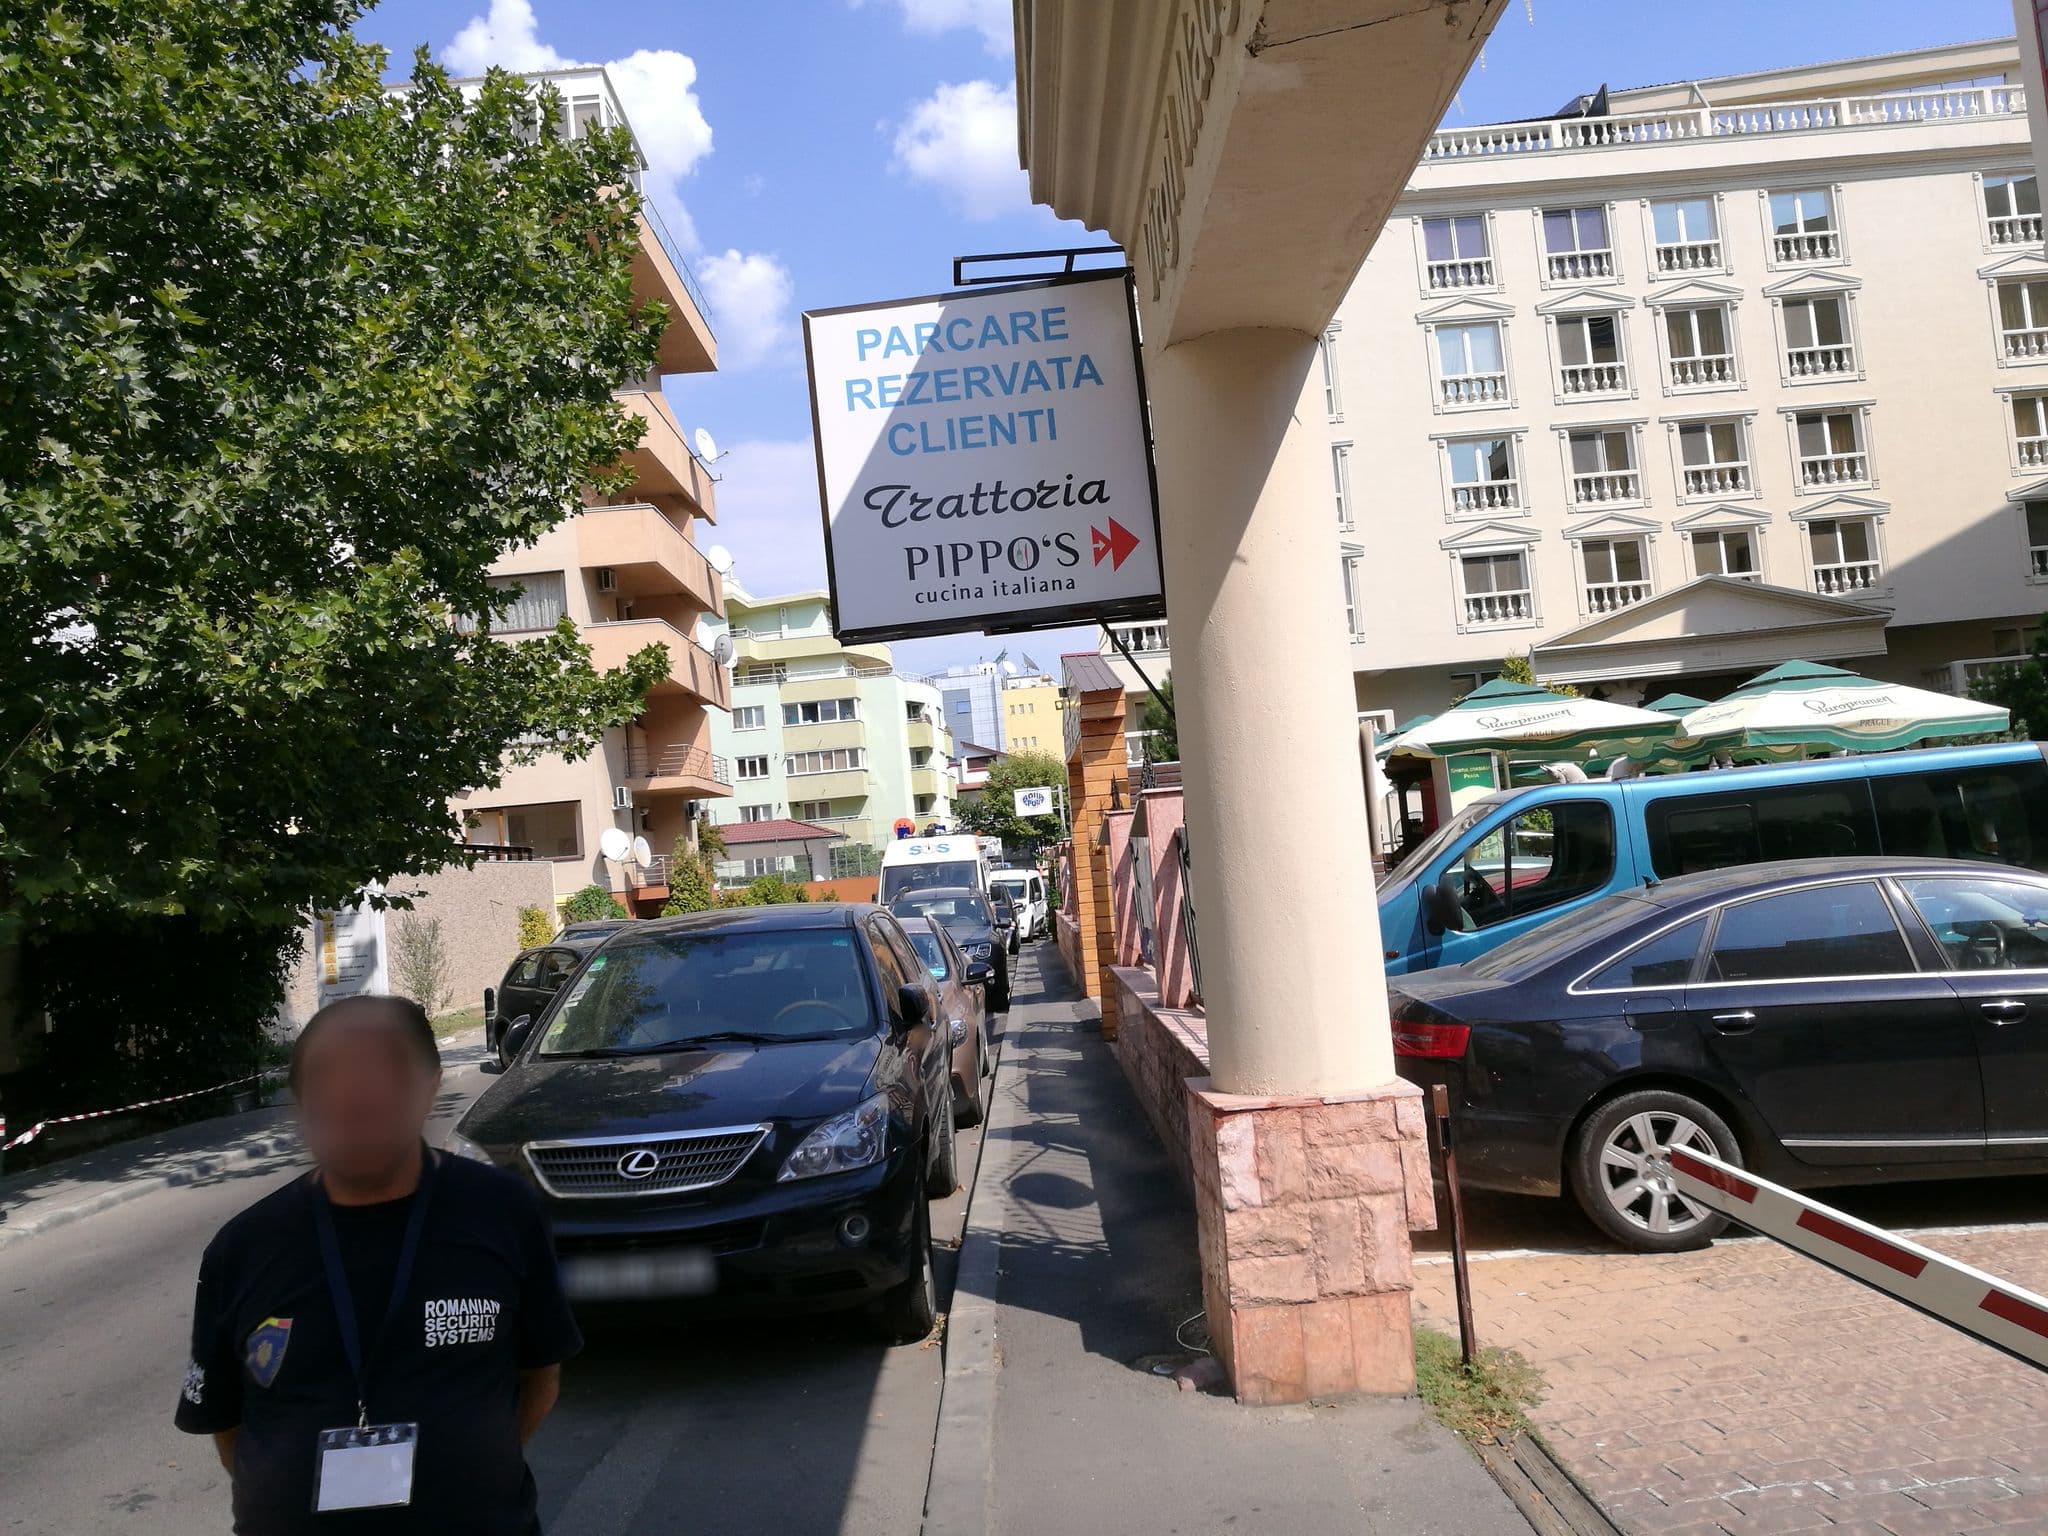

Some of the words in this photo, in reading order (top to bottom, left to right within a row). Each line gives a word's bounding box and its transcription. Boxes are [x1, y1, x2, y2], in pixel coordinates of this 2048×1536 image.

[856, 306, 1069, 362] PARCARE
[845, 353, 1105, 412] REZERVATA
[887, 407, 1058, 457] CLIENTI
[863, 473, 1111, 529] Trattoria
[903, 532, 1080, 581] PIPPO'S
[914, 585, 984, 605] cucina
[992, 576, 1077, 598] italiana
[1476, 709, 1576, 730] Staropramen
[1803, 695, 1896, 715] Staropramen
[425, 1298, 501, 1319] ROMANIAN
[424, 1314, 497, 1333] SECURITY
[424, 1327, 495, 1348] SYSTEMS
